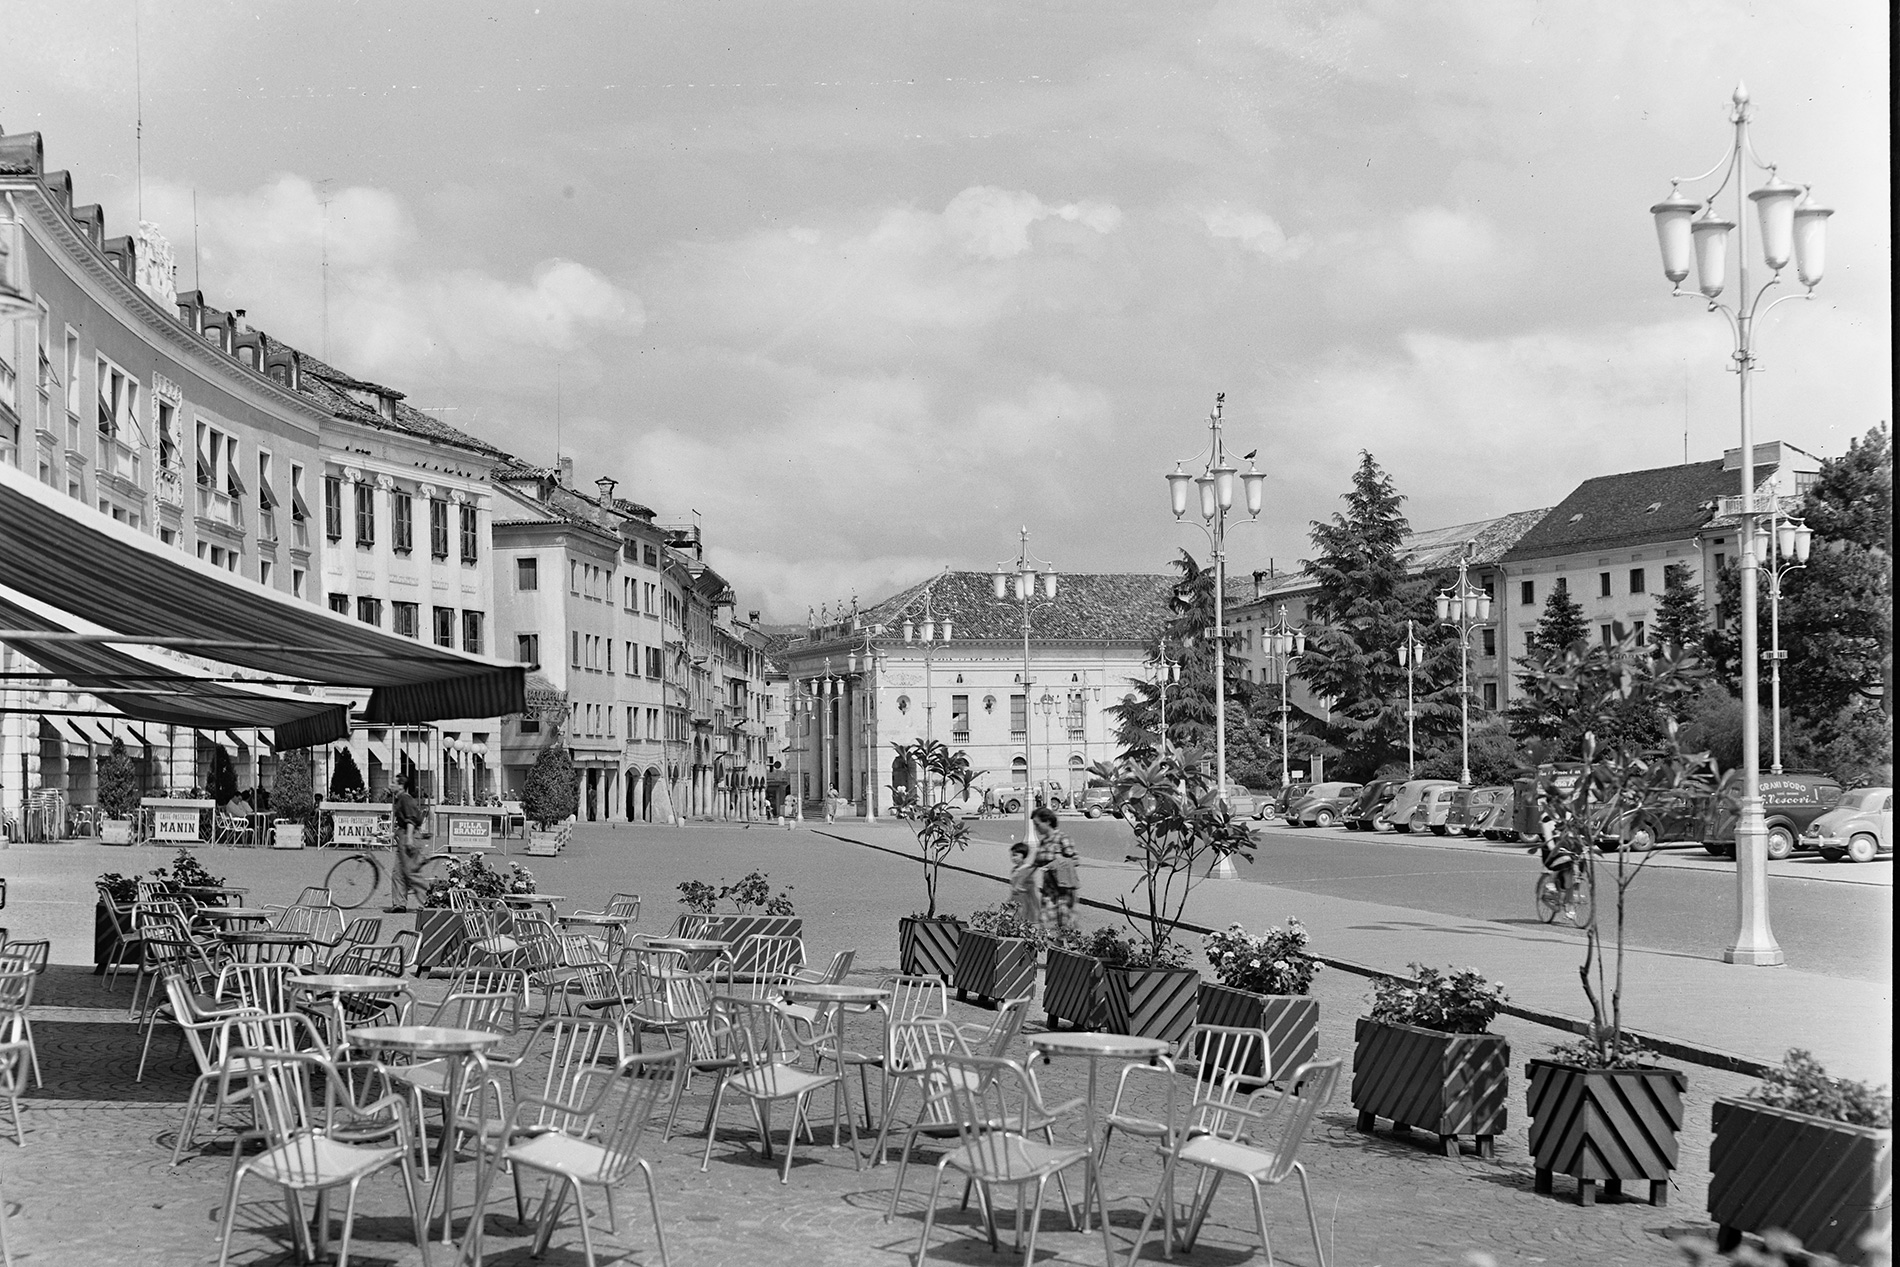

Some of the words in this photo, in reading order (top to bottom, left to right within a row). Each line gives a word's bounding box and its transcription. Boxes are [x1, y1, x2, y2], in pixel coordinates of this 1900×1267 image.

[1759, 781, 1782, 791] GRANI
[1783, 781, 1807, 792] D'ORO
[160, 821, 195, 833] MANIN
[338, 825, 373, 836] MANIN
[459, 821, 482, 829] PILLA
[454, 828, 487, 836] BRANDY
